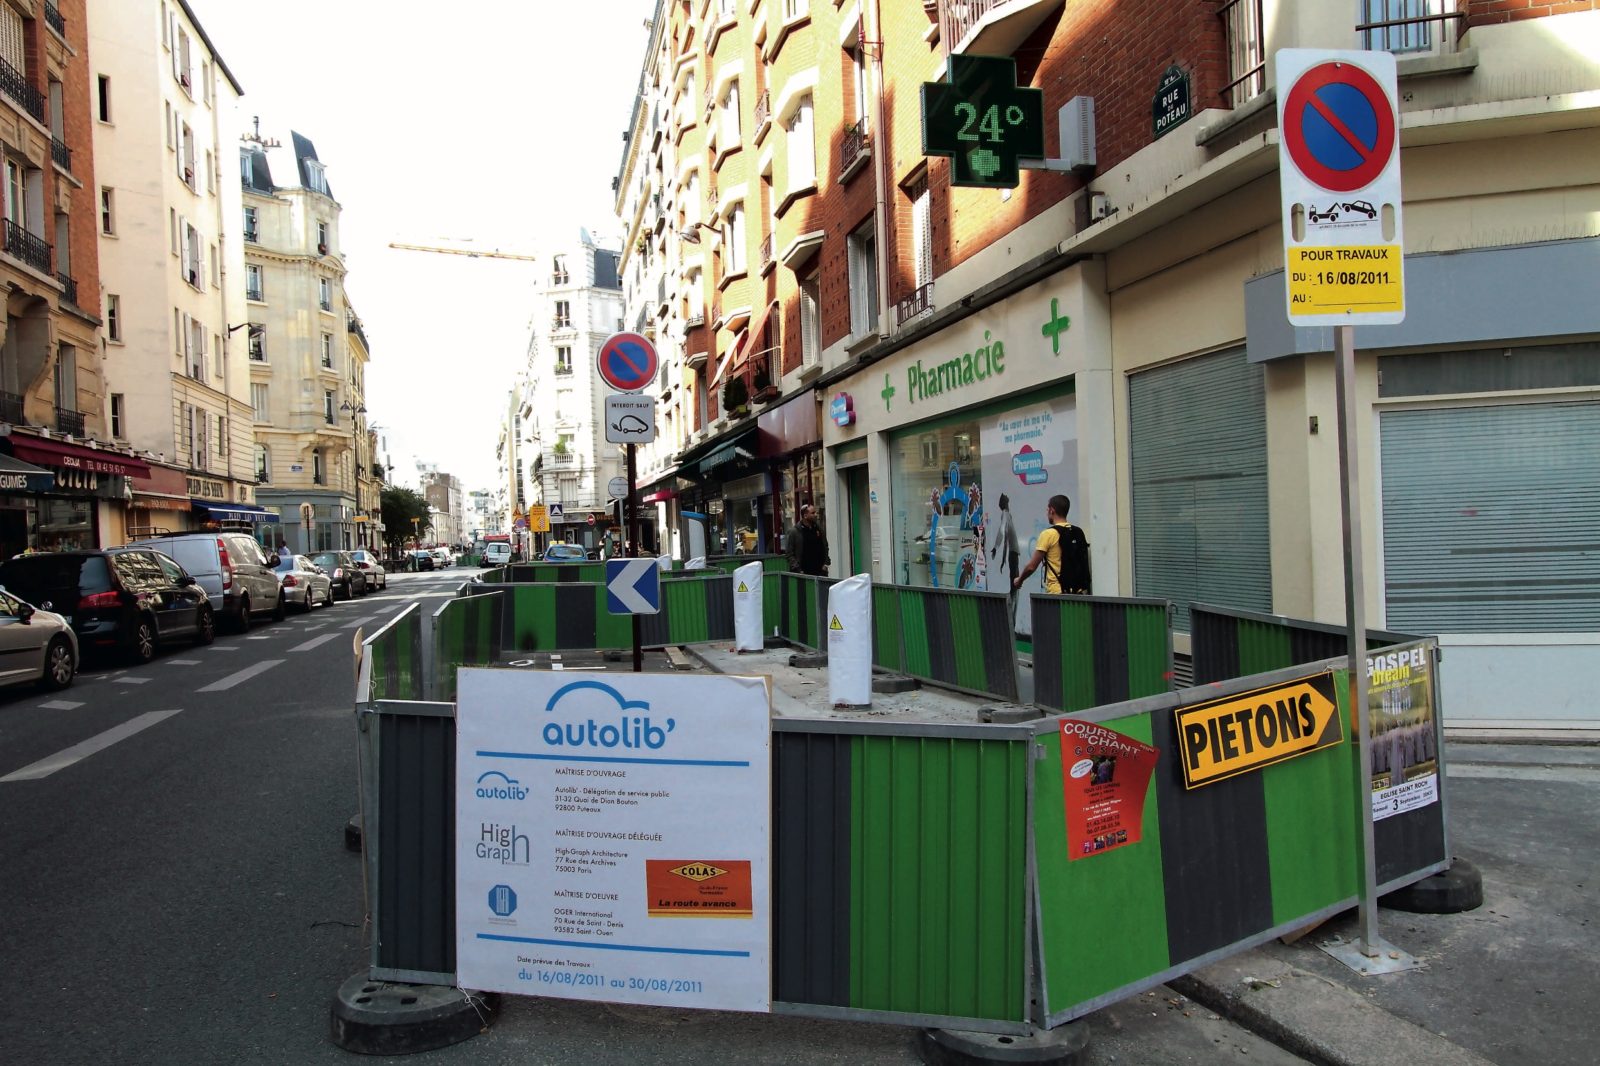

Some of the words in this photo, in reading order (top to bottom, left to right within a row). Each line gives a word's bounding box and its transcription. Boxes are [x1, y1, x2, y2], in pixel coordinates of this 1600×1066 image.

[1162, 88, 1179, 108] RUE
[954, 102, 1024, 142] 24°
[1156, 102, 1186, 130] POTEAU
[1301, 250, 1334, 261] POUR
[1336, 249, 1389, 260] TRAVAUX
[1292, 272, 1306, 282] DU
[1292, 293, 1306, 303] AU
[907, 330, 1006, 404] Pharmacie
[1013, 457, 1042, 472] Pharma
[1366, 647, 1427, 678] GOSPEL
[1064, 722, 1118, 740] COURS
[1185, 692, 1316, 770] PIETONS
[1087, 735, 1141, 755] CHANT
[554, 767, 585, 776] MAÎTRISE
[586, 769, 627, 778] D'OUVRAGE
[650, 790, 670, 798] public
[1380, 788, 1398, 800] EGLISE
[1398, 784, 1414, 794] SAINT
[1414, 780, 1428, 790] ROCH
[1392, 798, 1399, 811] 3
[555, 828, 585, 838] MAÎTRISE
[586, 831, 627, 840] D'OUVRAGE
[628, 831, 663, 842] DÉLÉGUÉE
[591, 850, 628, 858] Architecture
[555, 865, 576, 873] 75003
[681, 867, 716, 876] COLAS
[554, 889, 583, 899] MAÎTRISE
[585, 892, 619, 901] D'OEUVRE
[658, 899, 671, 907] La
[554, 908, 573, 916] OGER
[574, 909, 613, 919] International
[586, 919, 602, 927] Saint
[576, 927, 592, 935] Saint
[517, 955, 532, 964] Date
[532, 957, 553, 966] prévue
[566, 960, 591, 968] Travaux
[518, 968, 532, 981] du
[537, 970, 605, 987] 16/08/2011
[610, 980, 625, 989] au
[629, 977, 702, 993] 30/08/2011
